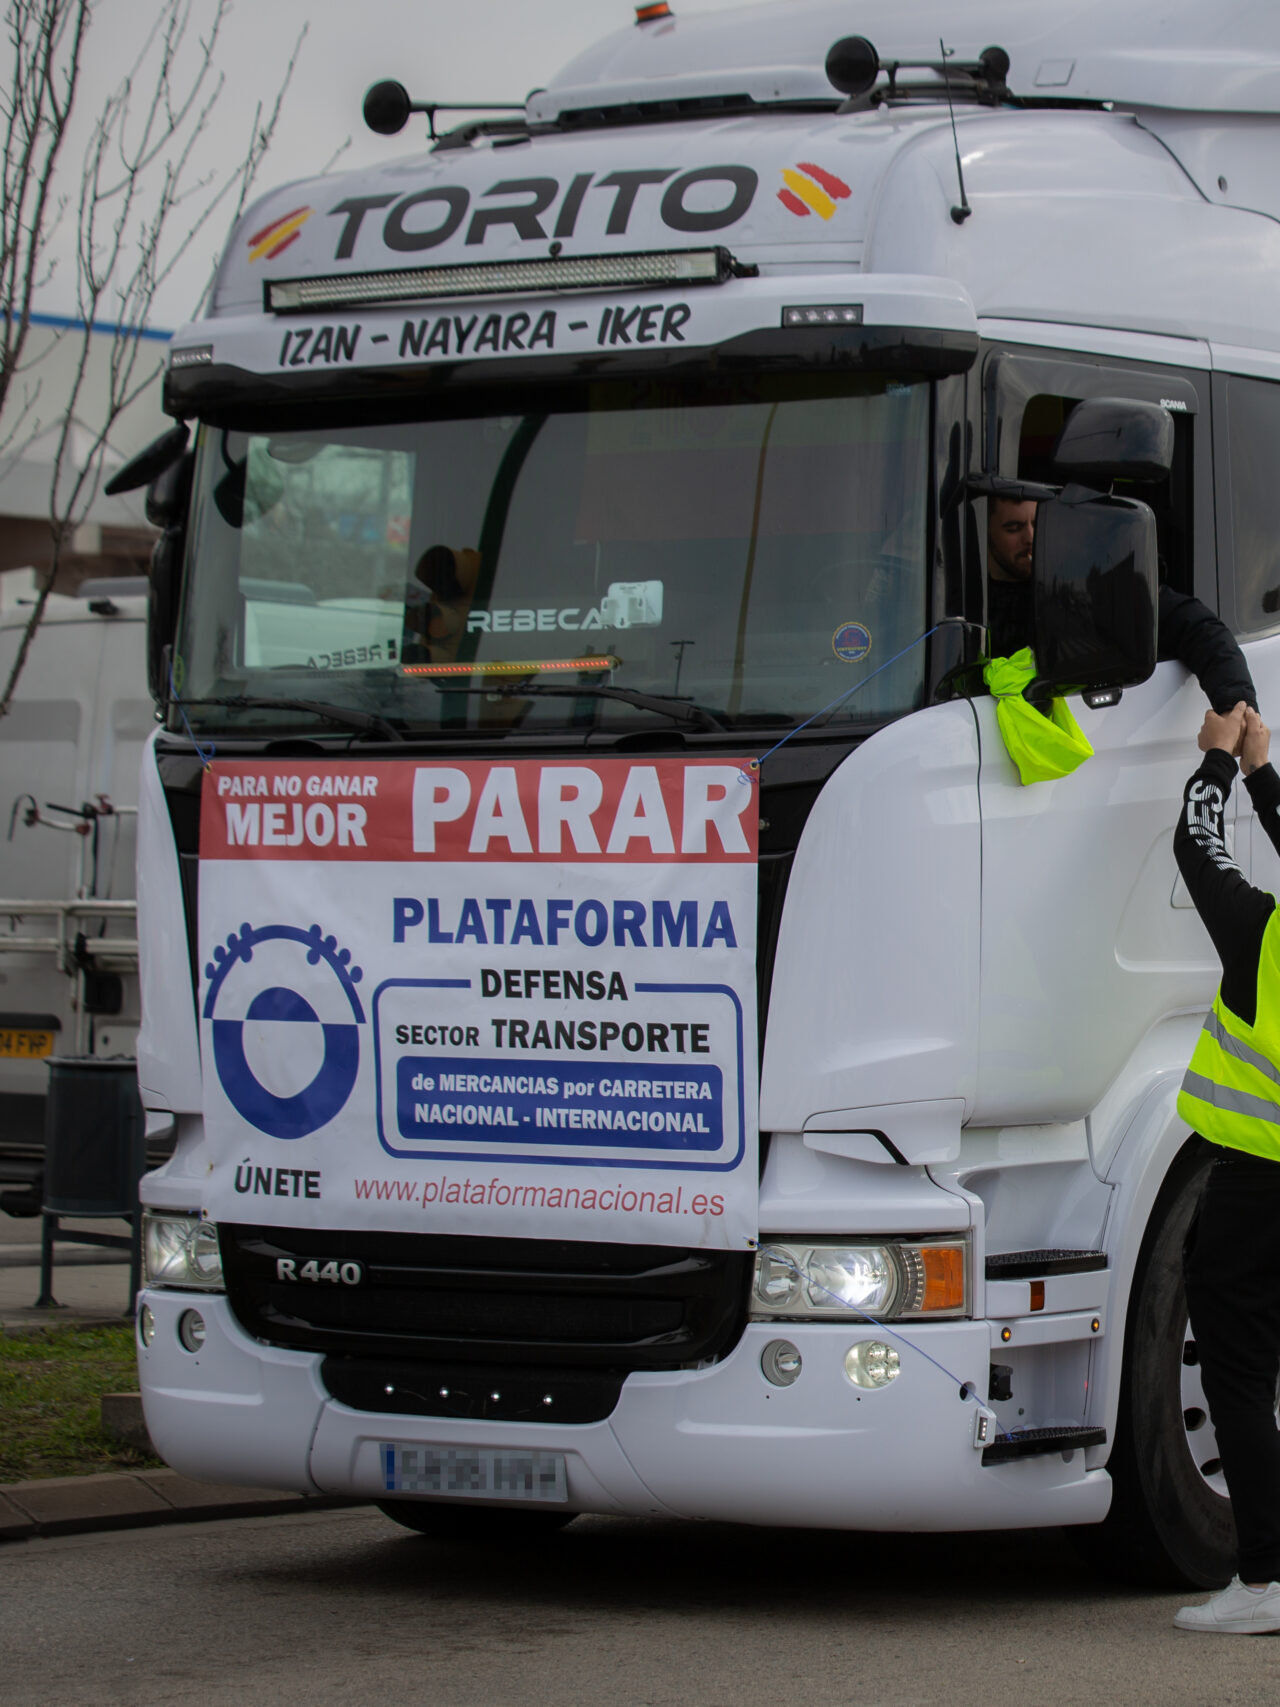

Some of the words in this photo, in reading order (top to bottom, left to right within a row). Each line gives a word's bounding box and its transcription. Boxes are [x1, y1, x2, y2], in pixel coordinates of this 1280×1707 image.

[328, 164, 759, 260] TORITO
[279, 323, 363, 367] IZAN
[398, 311, 556, 358] NAYARA
[597, 303, 691, 346] IKER
[1160, 398, 1187, 410] SCANIA
[467, 608, 608, 633] REBECA
[218, 776, 269, 796] PARA
[273, 776, 302, 796] NO
[306, 776, 379, 796] GANAR
[226, 803, 367, 846] MEJOR
[412, 766, 753, 854] PARAR
[392, 898, 737, 948] PLATAFORMA
[480, 968, 629, 1001] DEFENSA
[396, 1024, 480, 1047] SECTOR
[491, 1018, 710, 1053] TRANSPORTE
[412, 1074, 435, 1091] de
[439, 1074, 559, 1095] MERCANCIAS
[563, 1082, 595, 1100] por
[599, 1079, 713, 1100] CARRETERA
[415, 1103, 519, 1126] NACIONAL
[536, 1107, 709, 1133] INTERNACIONAL
[234, 1157, 321, 1198] ÚNETE
[353, 1175, 725, 1217] www.plataformanacional.es
[276, 1258, 297, 1280] R
[300, 1260, 361, 1285] 440
